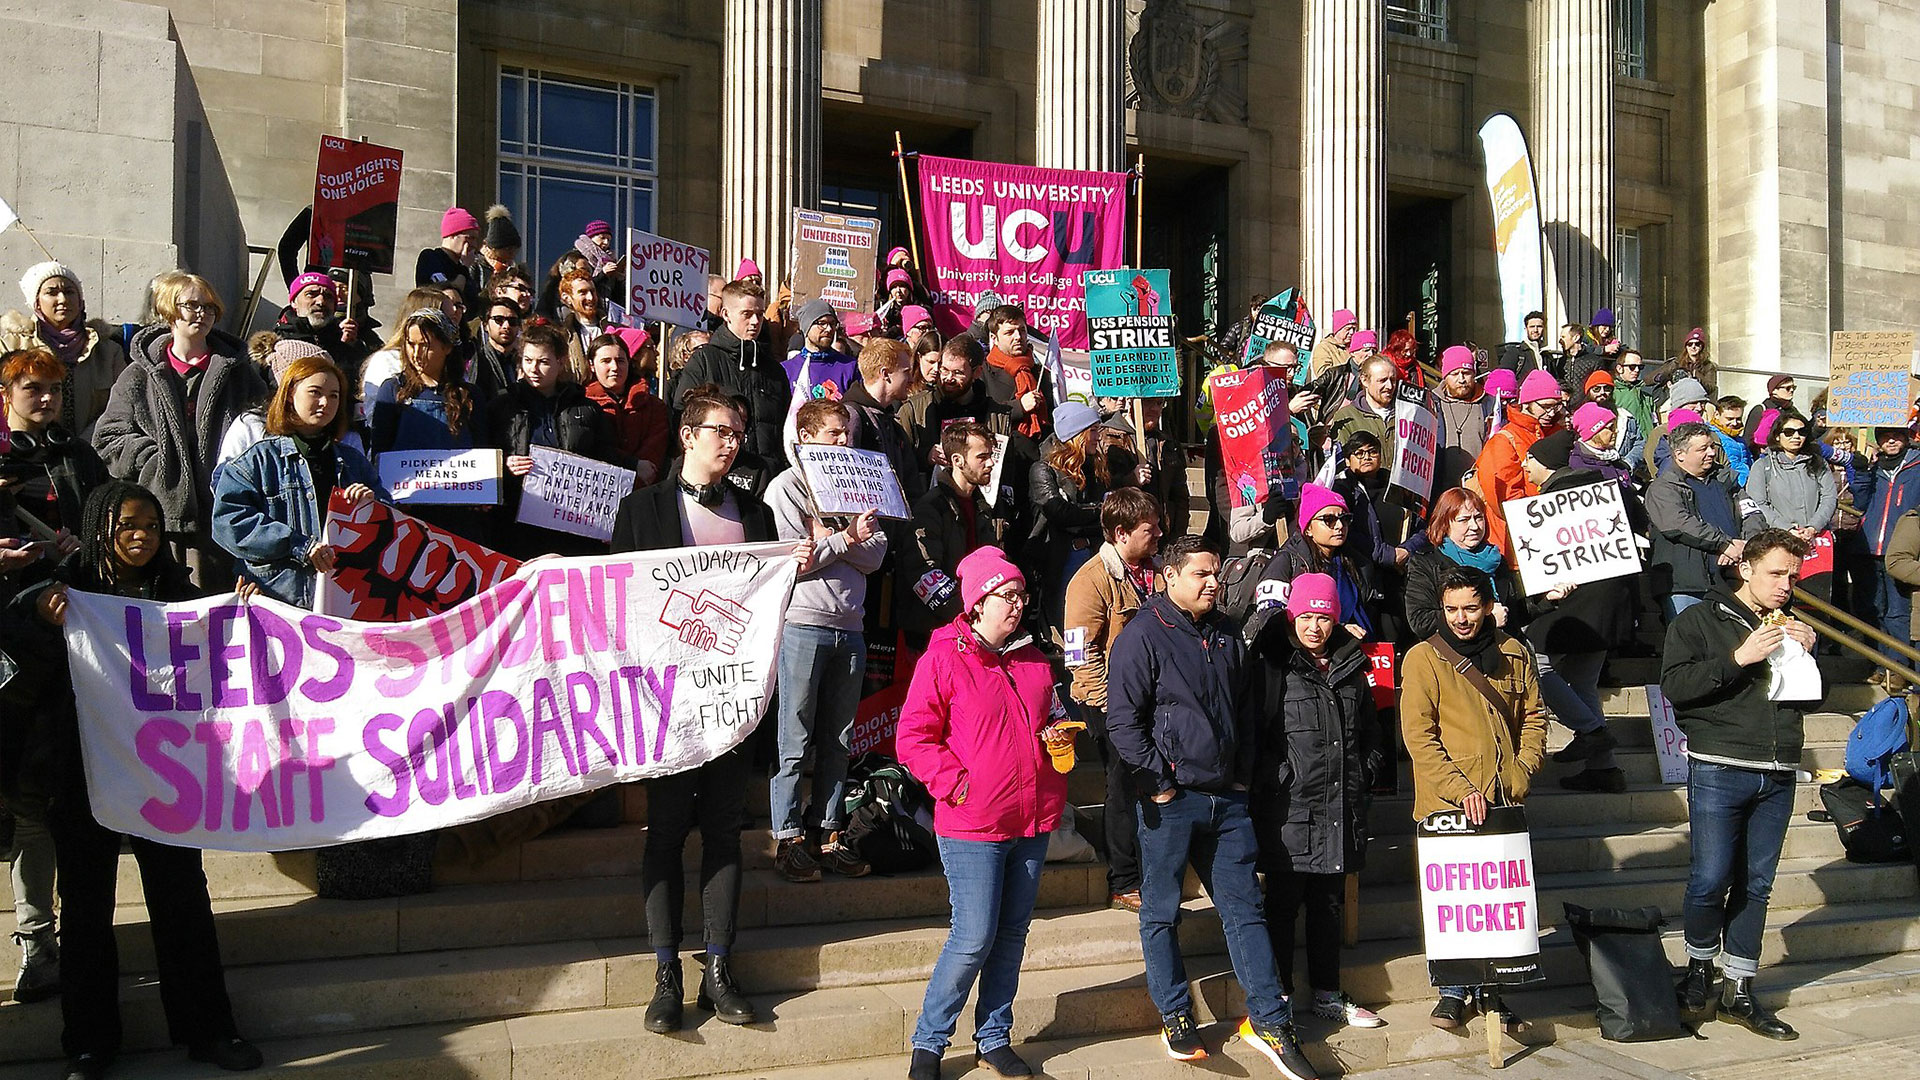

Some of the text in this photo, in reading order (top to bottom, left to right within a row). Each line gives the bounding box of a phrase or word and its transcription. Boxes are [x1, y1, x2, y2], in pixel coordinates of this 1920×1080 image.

[325, 138, 345, 150] UCU
[320, 158, 400, 187] FOUR FIGHTS
[320, 172, 385, 200] ONE VOICE
[930, 175, 1116, 204] LEEDS UNIVERSITY
[803, 228, 871, 247] UNIVERSITIES!
[950, 201, 1095, 265] UCU
[631, 242, 710, 274] SUPPORT
[828, 248, 848, 257] SHOW
[826, 257, 848, 267] MORAL
[649, 269, 683, 287] OUR
[818, 266, 856, 277] LEADERSHIP
[937, 266, 1001, 287] University
[1003, 272, 1026, 285] and
[1029, 273, 1073, 290] College
[1089, 273, 1115, 284] UCU
[829, 280, 848, 288] FIGHT
[930, 289, 1019, 306] DEFENNG
[1033, 311, 1070, 329] JOBS
[1091, 316, 1168, 329] USS PENSION
[1258, 313, 1314, 337] USS PENSION
[1093, 328, 1171, 350] STRIKE
[1253, 338, 1264, 347] WE
[1254, 322, 1312, 350] STRIKE
[1251, 346, 1263, 355] WE
[1835, 341, 1865, 350] STRESS
[1095, 352, 1171, 363] WE EARNED IT.
[1845, 348, 1902, 362] COURSES?
[1096, 363, 1172, 375] WE DESERVE IT.
[1833, 363, 1854, 371] WAIT
[1097, 375, 1173, 387] WE DEMAND IT.
[1215, 374, 1240, 387] UCU
[1848, 370, 1909, 387] SECURE
[1401, 384, 1424, 400] UCU
[1832, 386, 1908, 398] CONTRACTS
[1219, 377, 1286, 426] FOUR FIGHTS
[1841, 398, 1909, 409] REASONABLE
[1225, 393, 1281, 439] ONE VOICE
[1827, 409, 1907, 425] WORKLOADS
[401, 459, 477, 468] PICKET LINE
[809, 452, 883, 467] SUPPORT YOUR
[1401, 448, 1432, 481] PICKET
[415, 470, 458, 479] MEANS
[552, 461, 616, 486] STUDENTS
[821, 464, 883, 480] LECTURERS!
[393, 481, 483, 491] DO NOT CROSS
[545, 476, 616, 501] AND STAFF
[834, 478, 884, 492] JOIN THIS
[544, 490, 611, 516] UNITE AND
[843, 492, 883, 505] PICKET!
[1526, 481, 1617, 528] SUPPORT
[553, 508, 595, 527] FIGHT!
[1556, 519, 1606, 546] OUR
[1542, 538, 1632, 575] STRIKE
[652, 550, 767, 591] SOLIDARITY
[981, 573, 1005, 592] UCU
[1310, 599, 1332, 609] UCU
[125, 562, 634, 712] LEEDS STUDENT
[692, 661, 757, 689] UNITE
[699, 696, 764, 730] FIGHT
[135, 665, 678, 834] STAFF SOLIDARITY
[1423, 815, 1467, 831] UCU
[1425, 859, 1531, 892] OFFICIAL
[1437, 901, 1527, 933] PICKET
